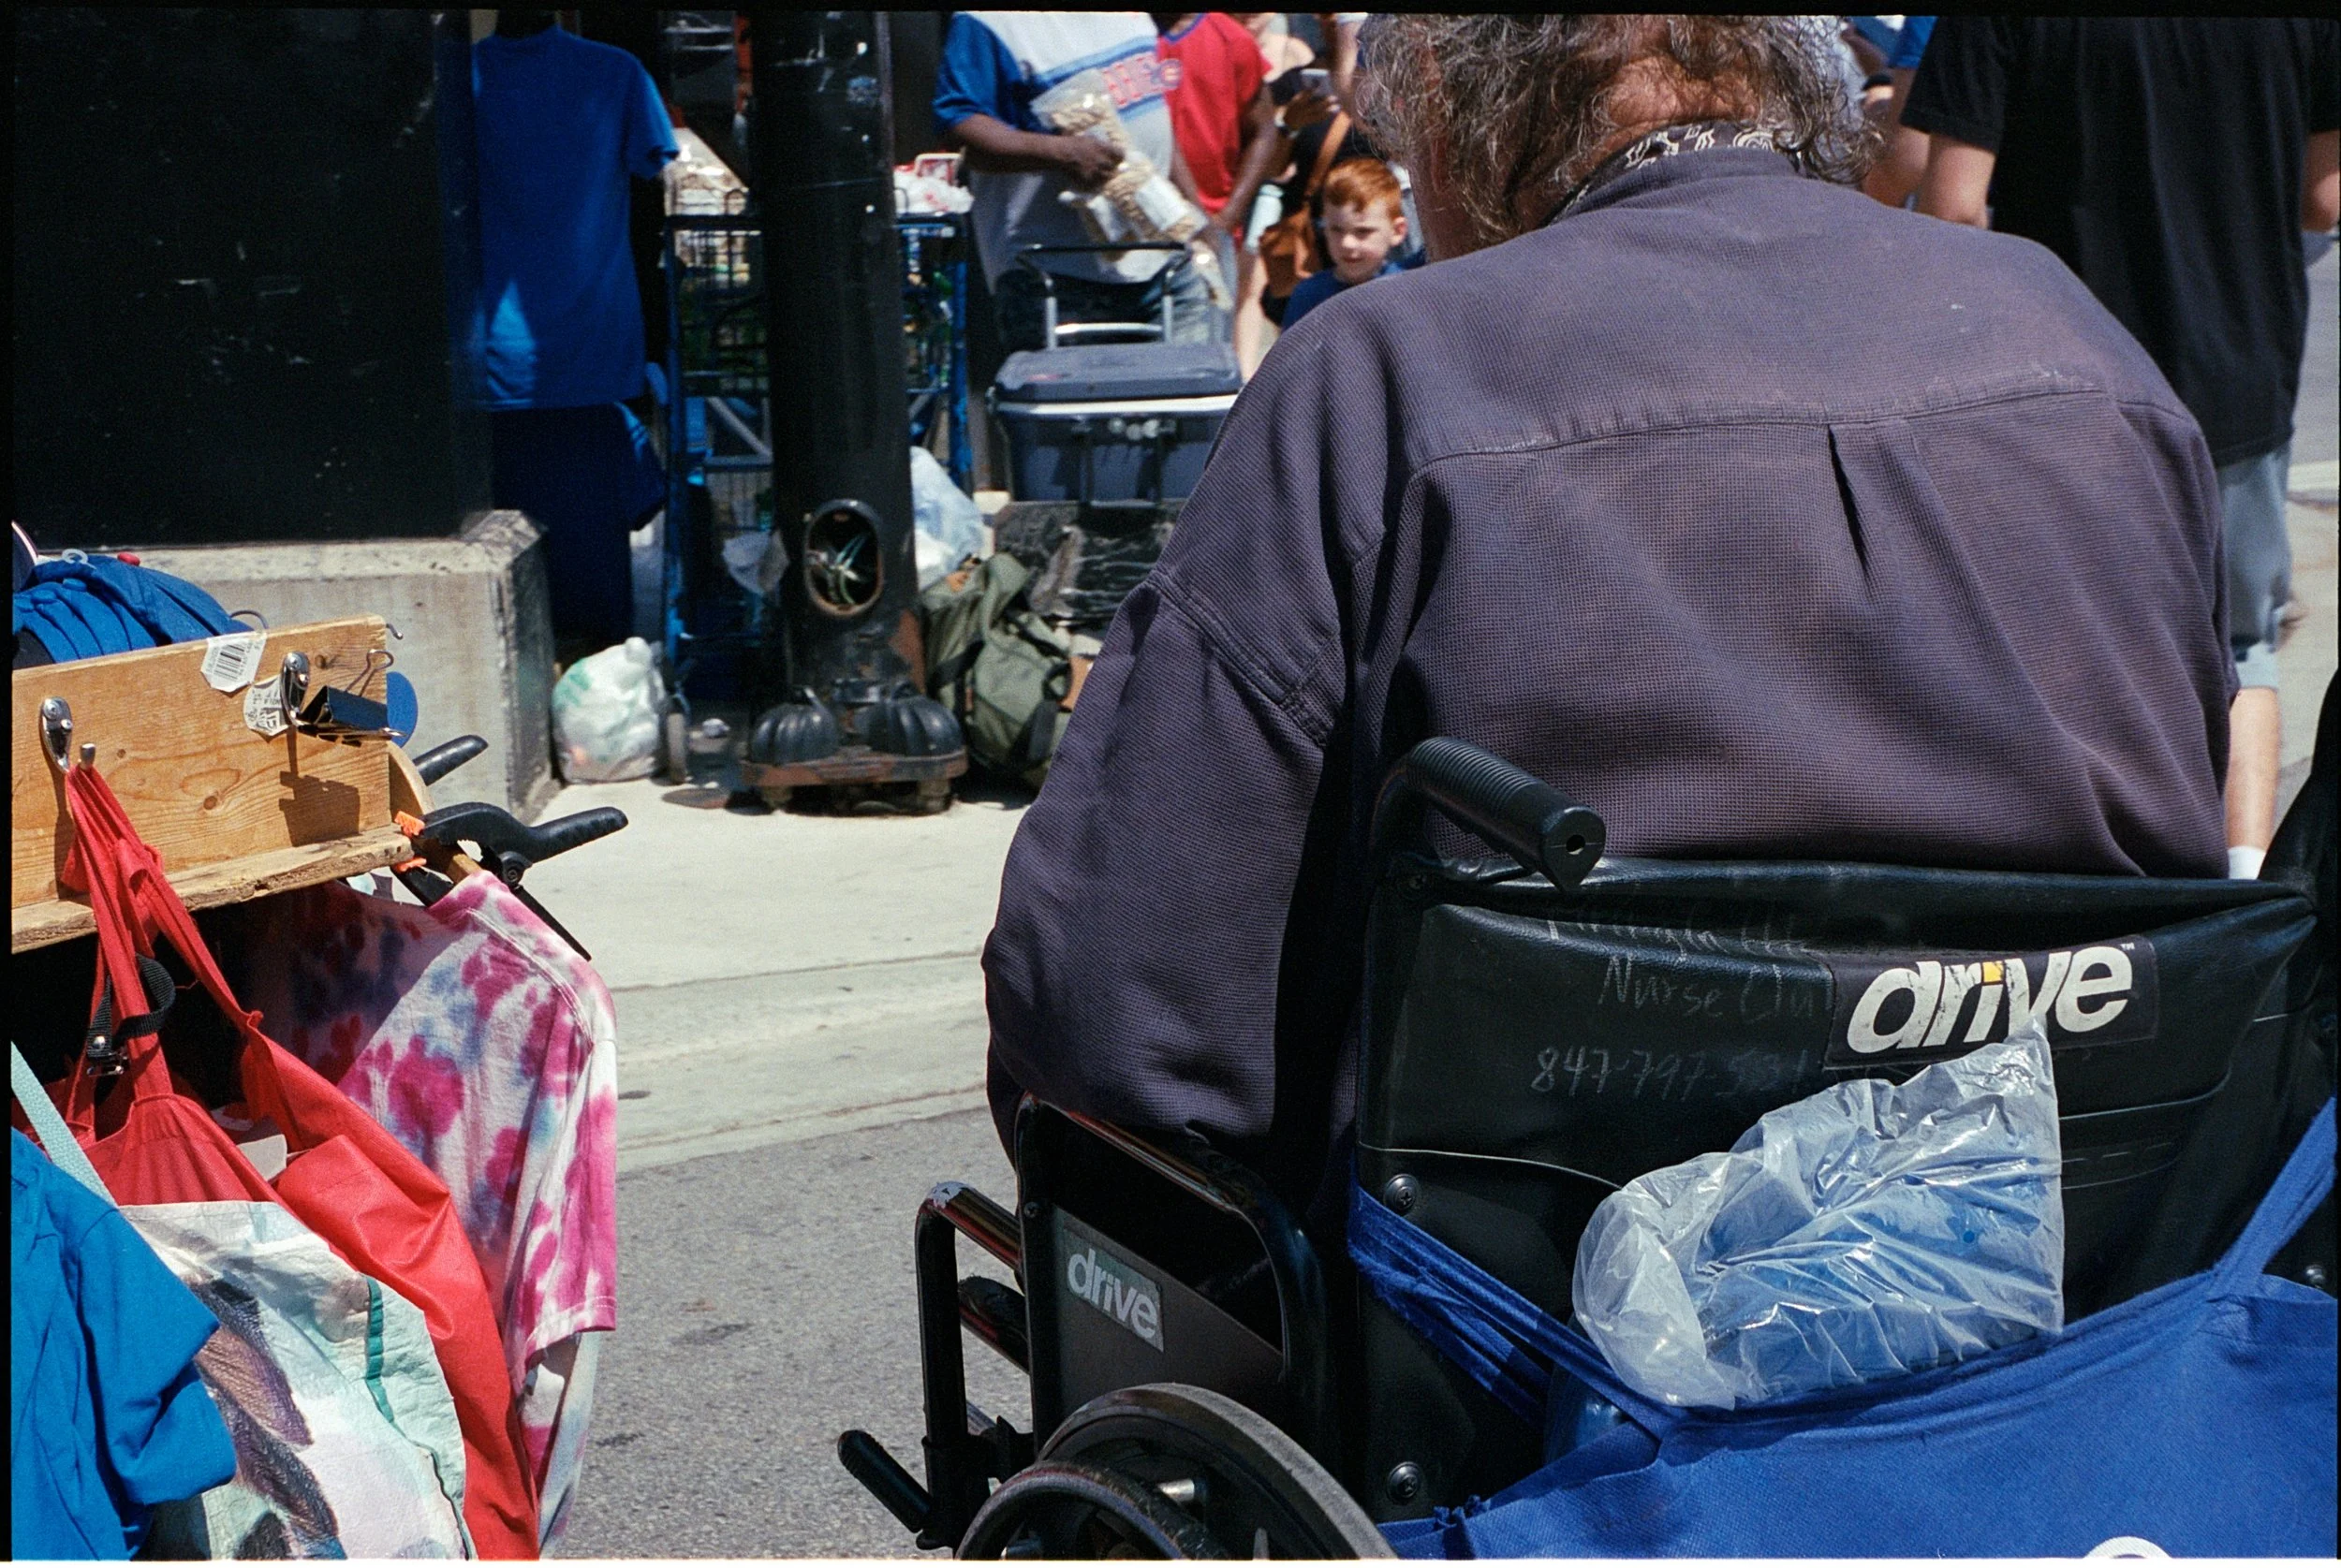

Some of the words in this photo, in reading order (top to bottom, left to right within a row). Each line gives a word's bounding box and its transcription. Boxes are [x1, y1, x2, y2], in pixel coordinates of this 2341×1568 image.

[1596, 953, 1724, 1018] Nurse
[1847, 945, 2133, 1055] drive
[1067, 1247, 1158, 1340] drive
